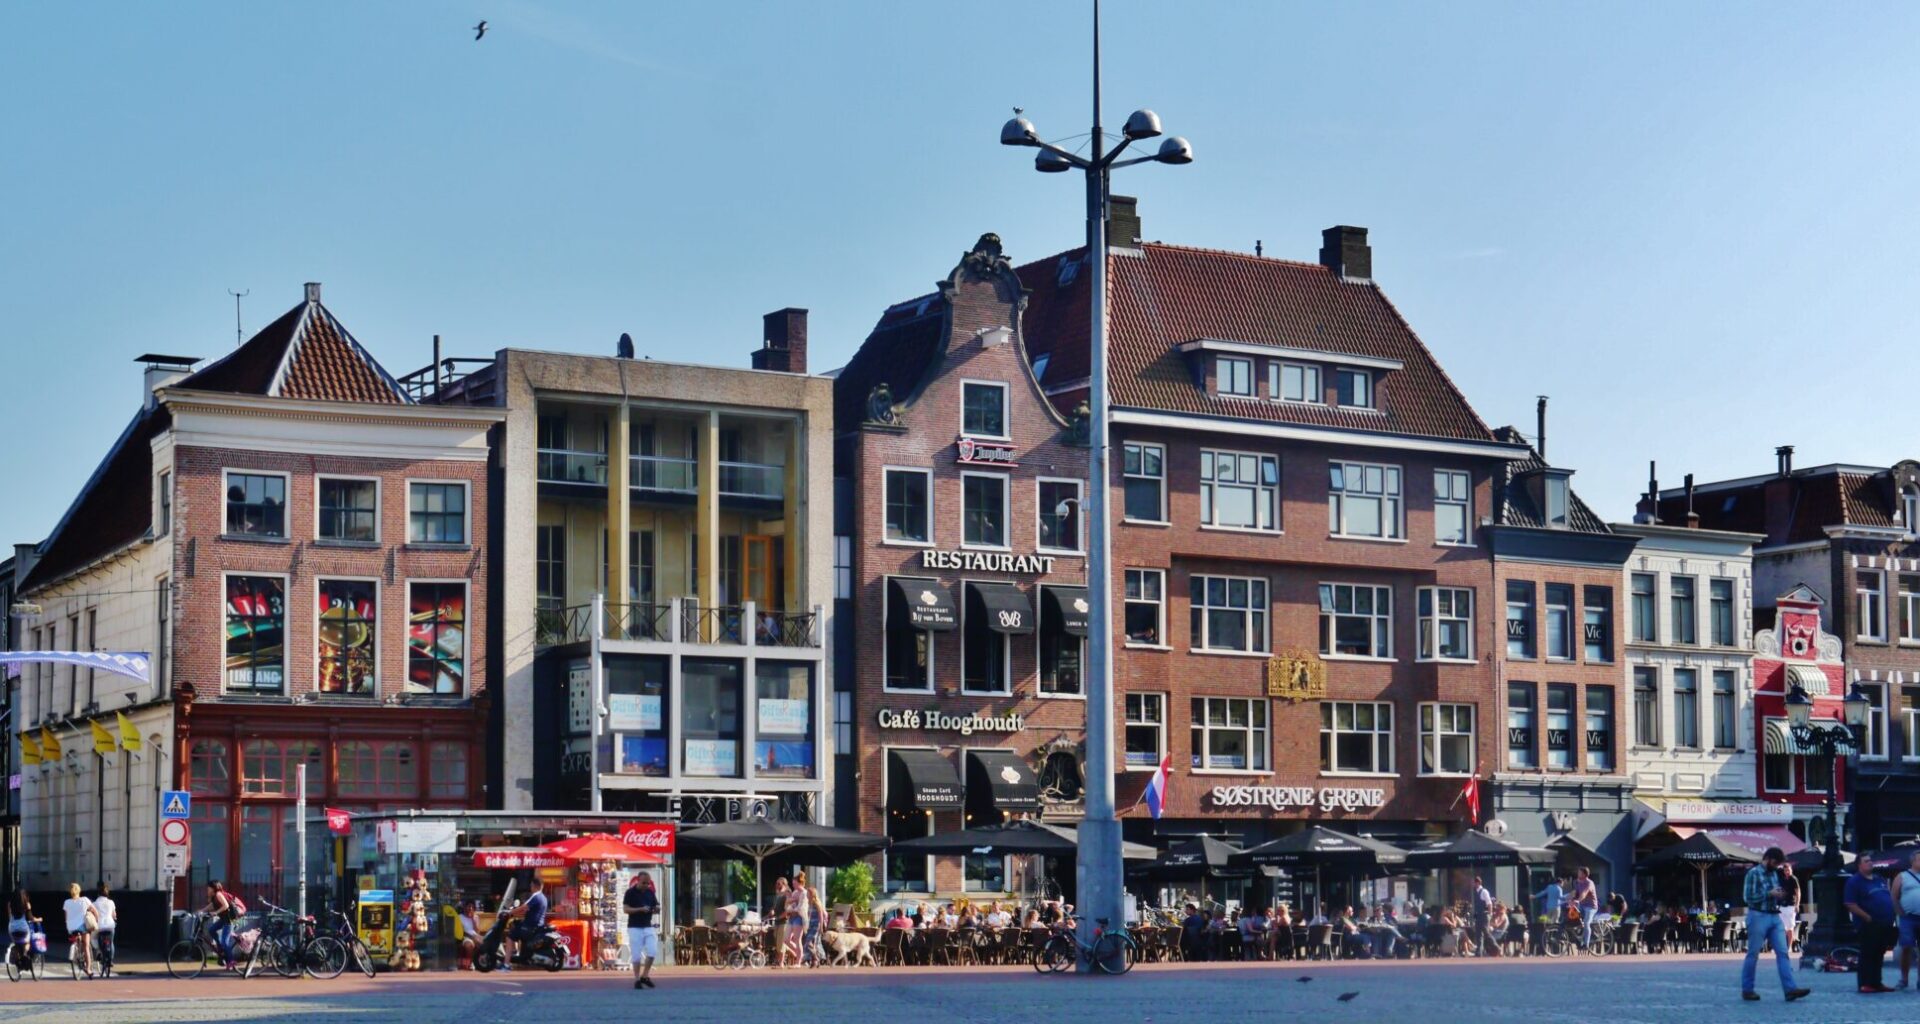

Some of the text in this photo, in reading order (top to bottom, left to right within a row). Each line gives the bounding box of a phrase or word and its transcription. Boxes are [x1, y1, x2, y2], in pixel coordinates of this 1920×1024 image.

[922, 549, 1056, 574] RESTAURANT
[1507, 620, 1525, 636] Vic
[1585, 624, 1602, 639] Vic
[234, 670, 280, 684] INGANG
[878, 708, 1025, 735] Café Hooghoudt
[1509, 729, 1527, 743] Vic
[1548, 730, 1566, 745] Vic
[1587, 731, 1603, 745] Vic
[561, 753, 592, 772] EXPO
[1211, 785, 1385, 812] SØSTRENE GRENE
[1723, 804, 1764, 815] VENEZIA
[1770, 804, 1782, 815] US
[485, 854, 522, 867] Gekoelde
